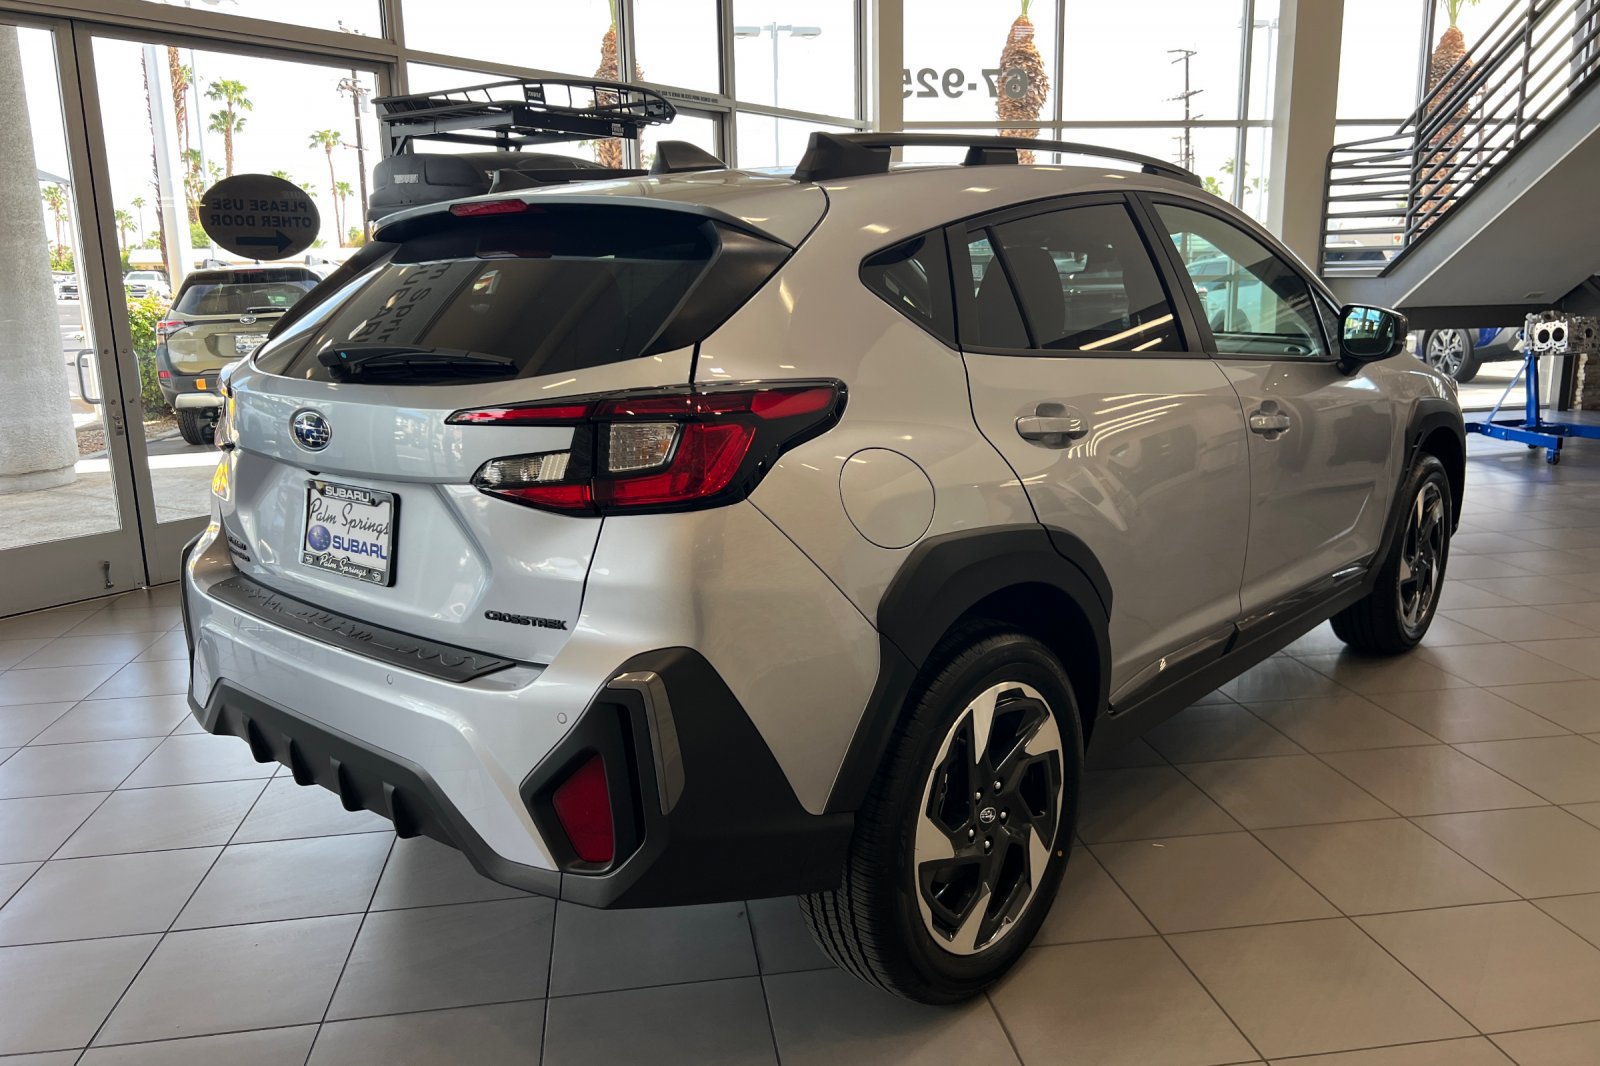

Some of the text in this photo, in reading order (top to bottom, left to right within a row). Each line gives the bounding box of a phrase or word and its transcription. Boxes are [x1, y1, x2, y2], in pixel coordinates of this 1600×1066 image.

[325, 486, 370, 502] SUBARU
[310, 497, 389, 540] Palm Springs
[320, 553, 367, 577] Palm Springs
[484, 609, 568, 630] CROSSTREK
